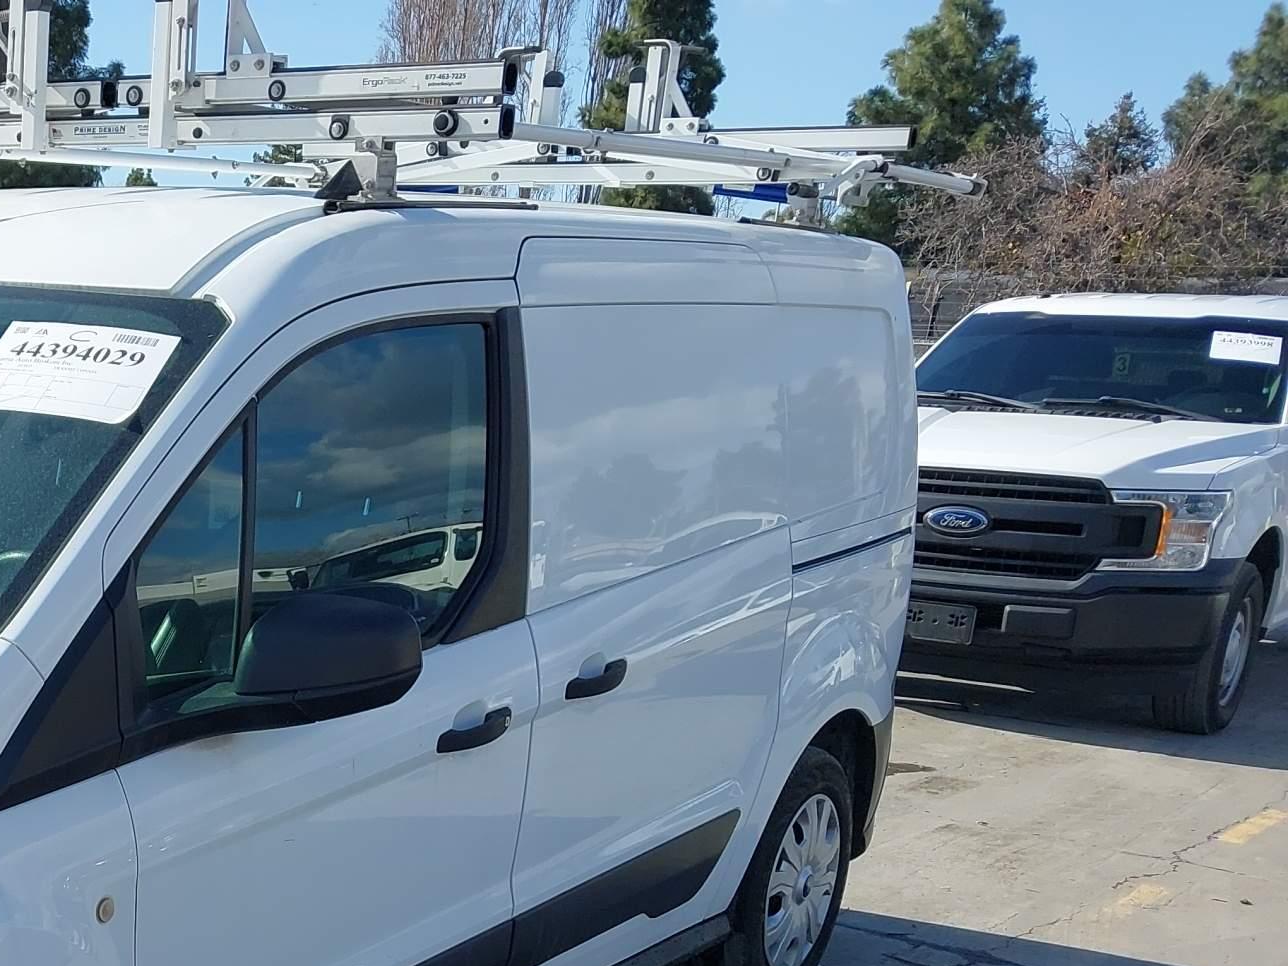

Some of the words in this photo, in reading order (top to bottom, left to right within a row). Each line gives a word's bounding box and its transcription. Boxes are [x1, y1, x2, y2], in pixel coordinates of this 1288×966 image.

[425, 72, 467, 80] 877-463-7225
[10, 340, 146, 367] 44394029
[940, 513, 973, 528] Ford
